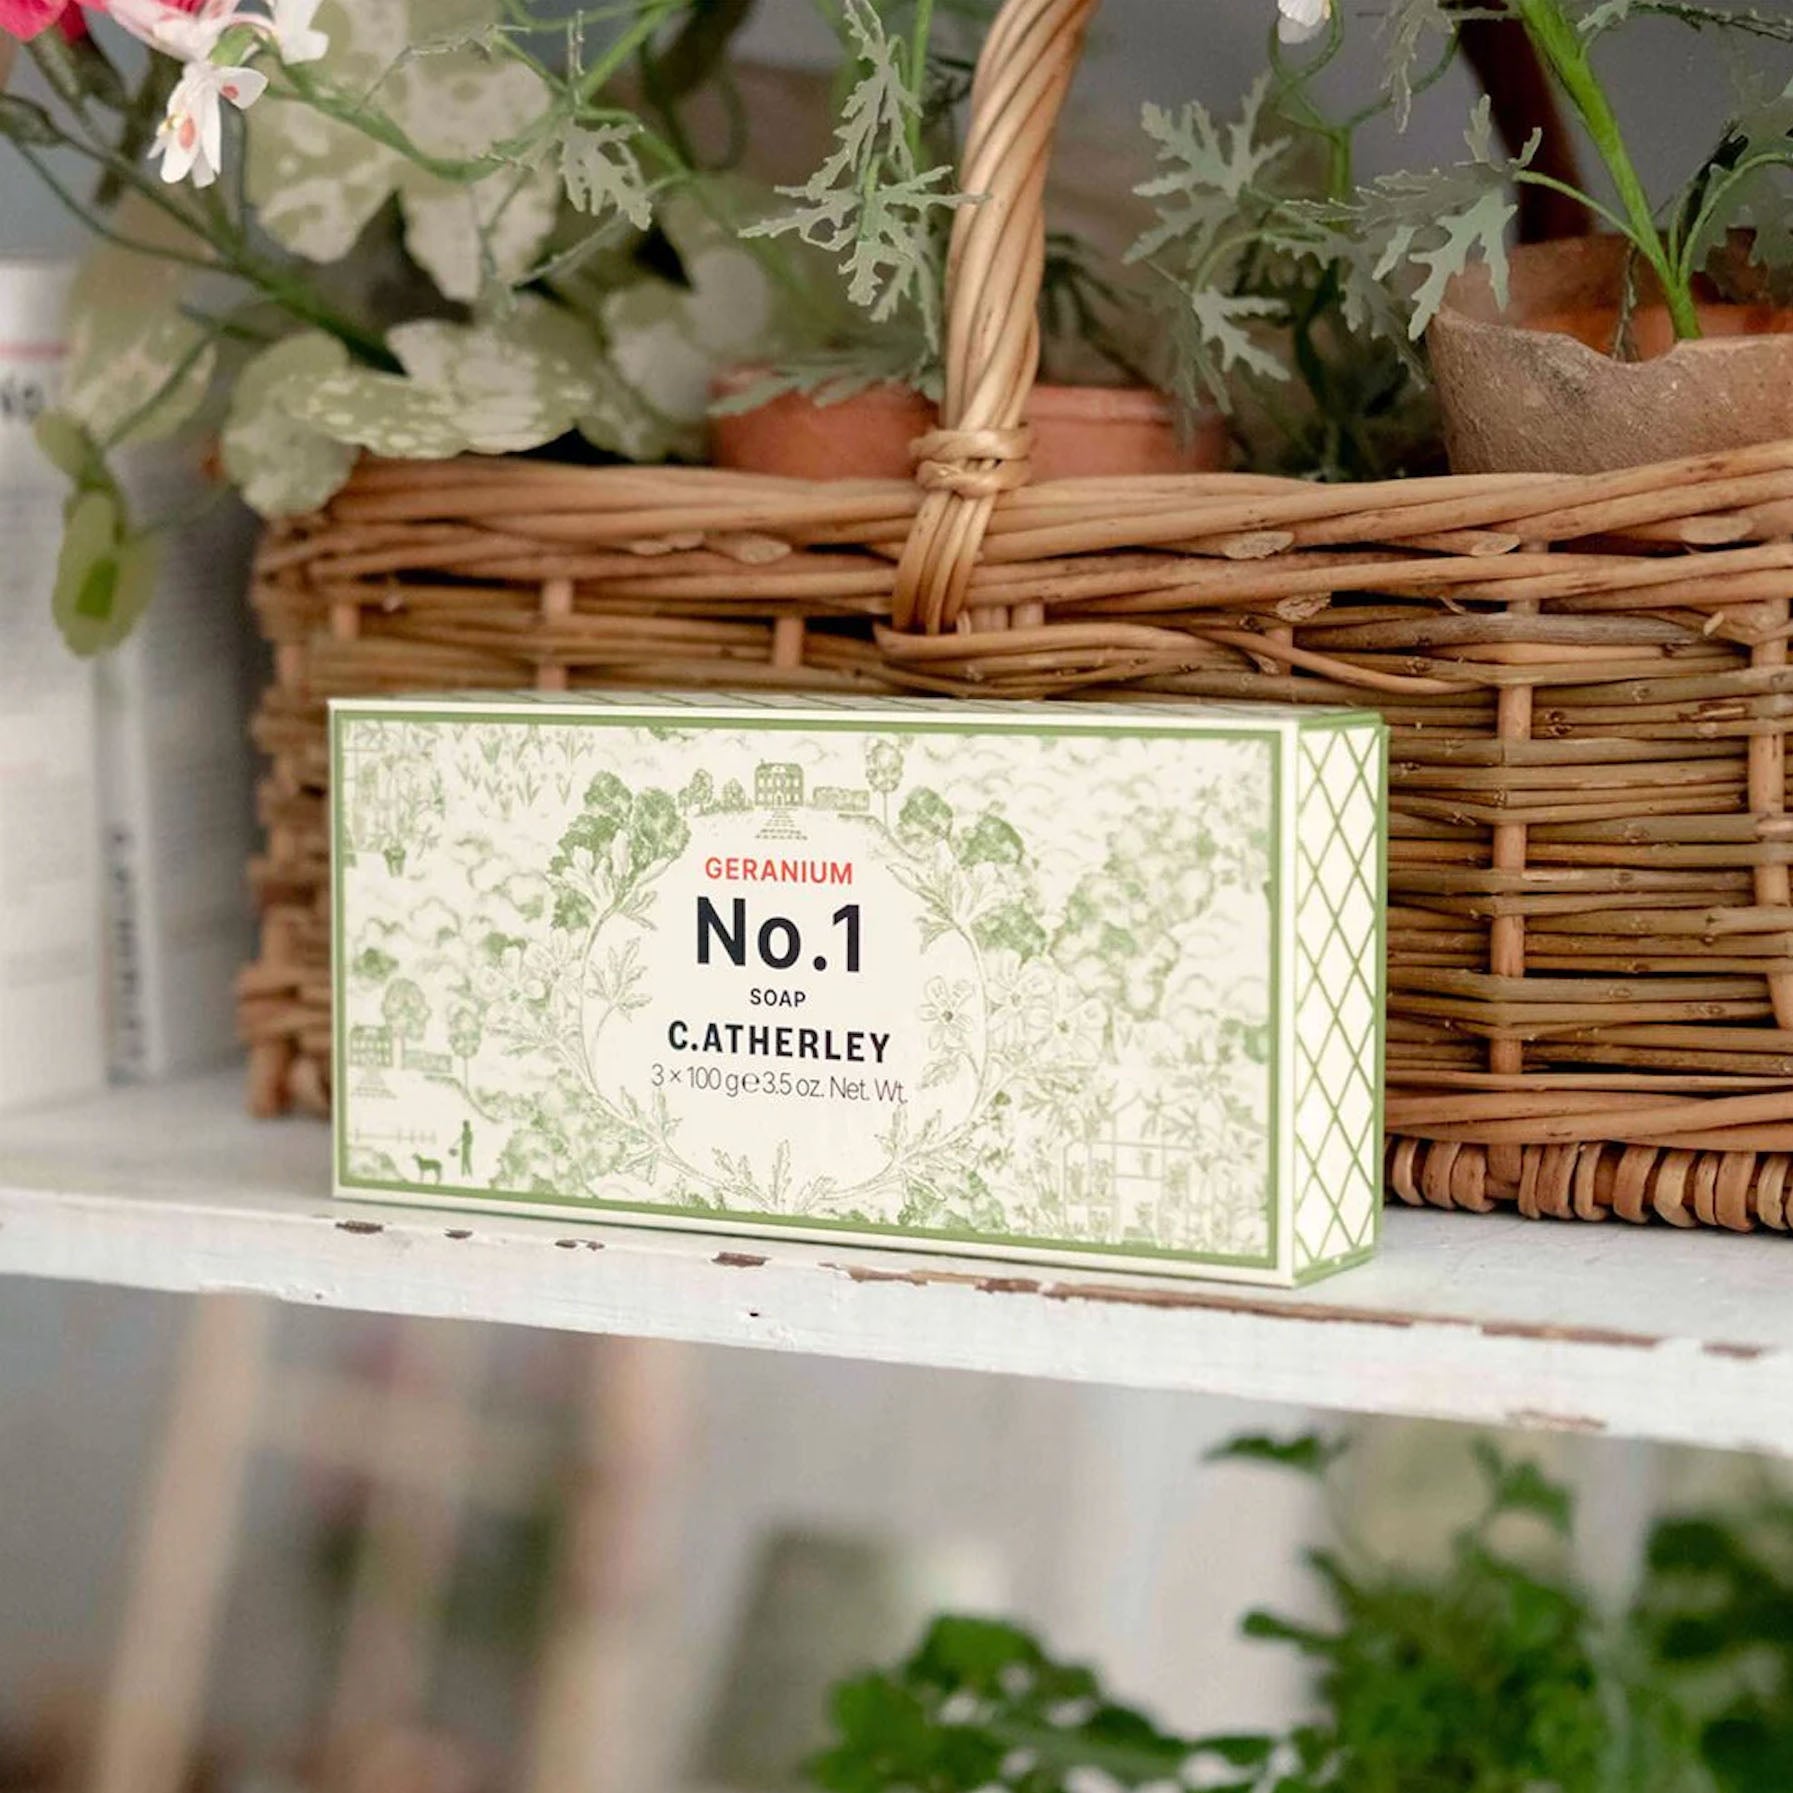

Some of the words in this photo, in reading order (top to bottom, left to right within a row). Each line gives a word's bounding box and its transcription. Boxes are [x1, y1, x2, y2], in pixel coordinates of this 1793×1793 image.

[705, 856, 853, 885] GERANIUM
[696, 896, 860, 973] No.1
[750, 988, 806, 1008] SOAP
[668, 1020, 890, 1064] C.ATHERLEY
[830, 1075, 870, 1101] Net.
[873, 1078, 908, 1105] Wt.
